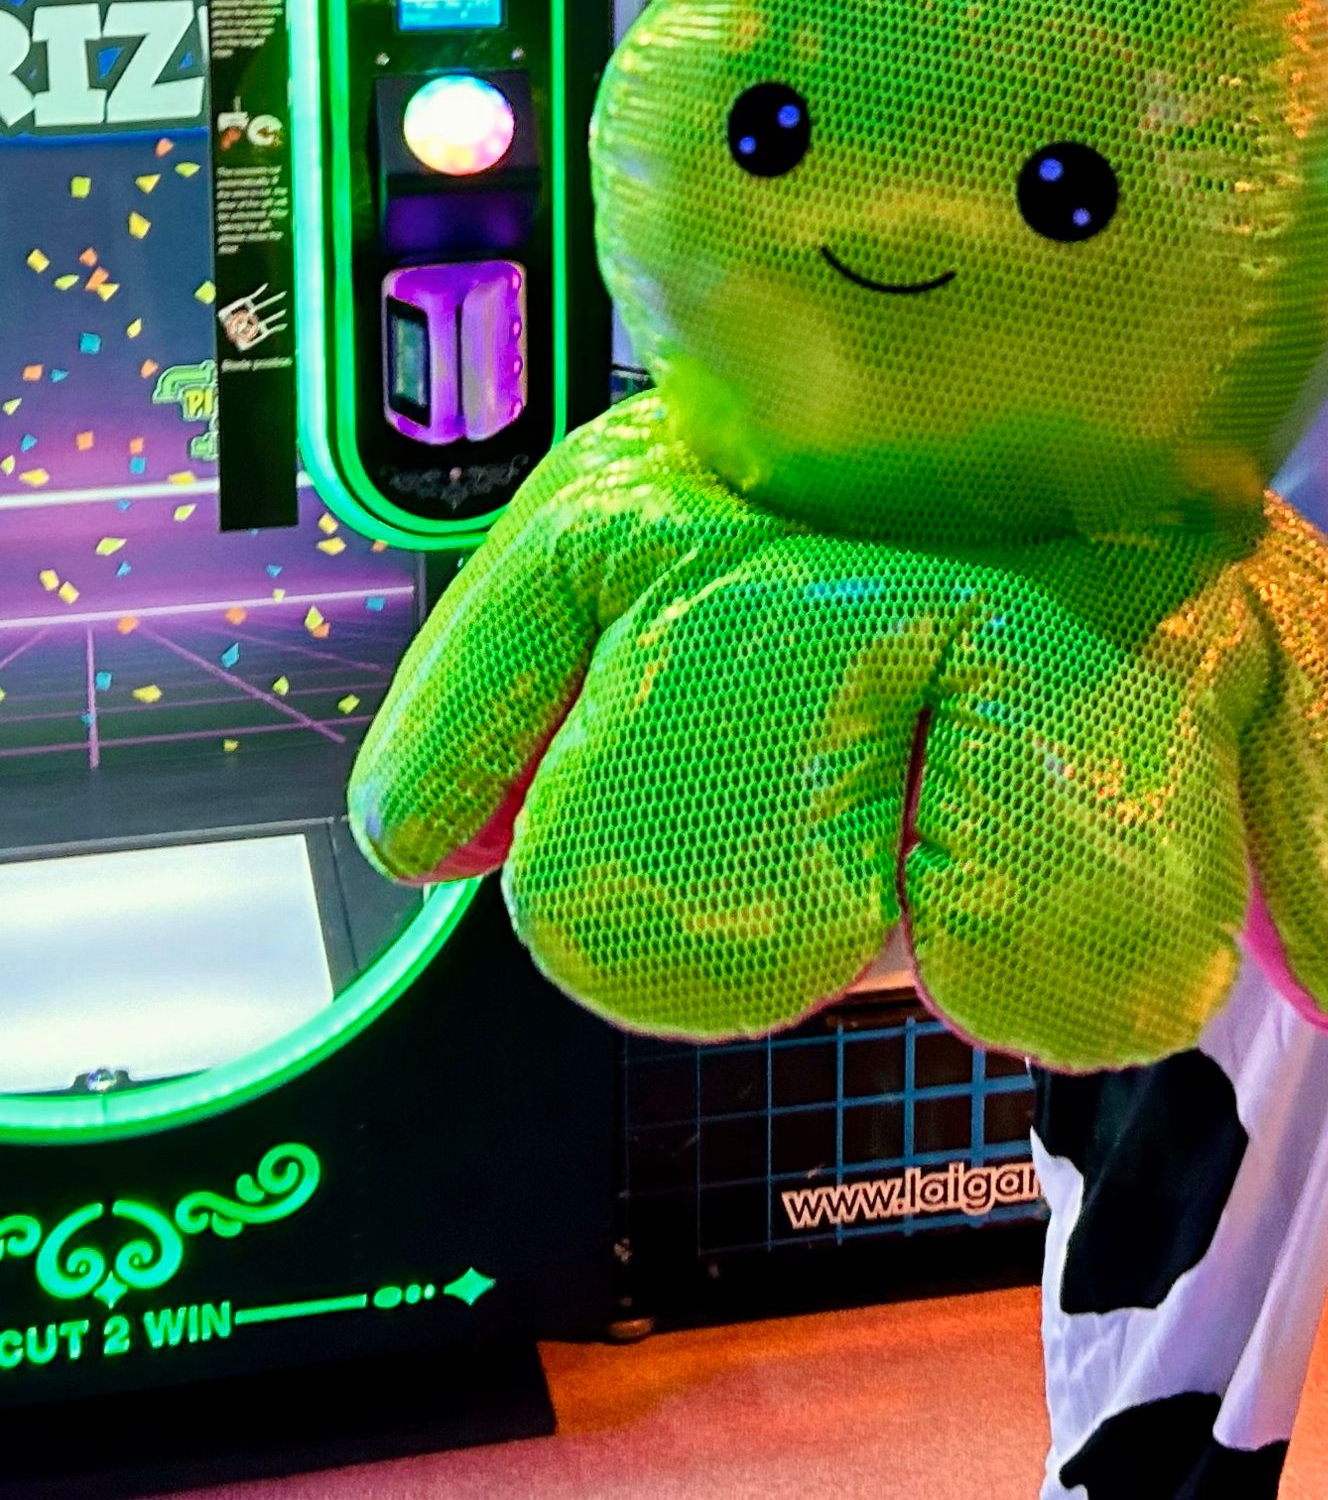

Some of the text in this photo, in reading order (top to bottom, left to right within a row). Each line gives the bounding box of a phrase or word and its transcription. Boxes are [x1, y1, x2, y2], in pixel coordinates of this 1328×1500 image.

[0, 1300, 232, 1368] CUT 2 WIN
